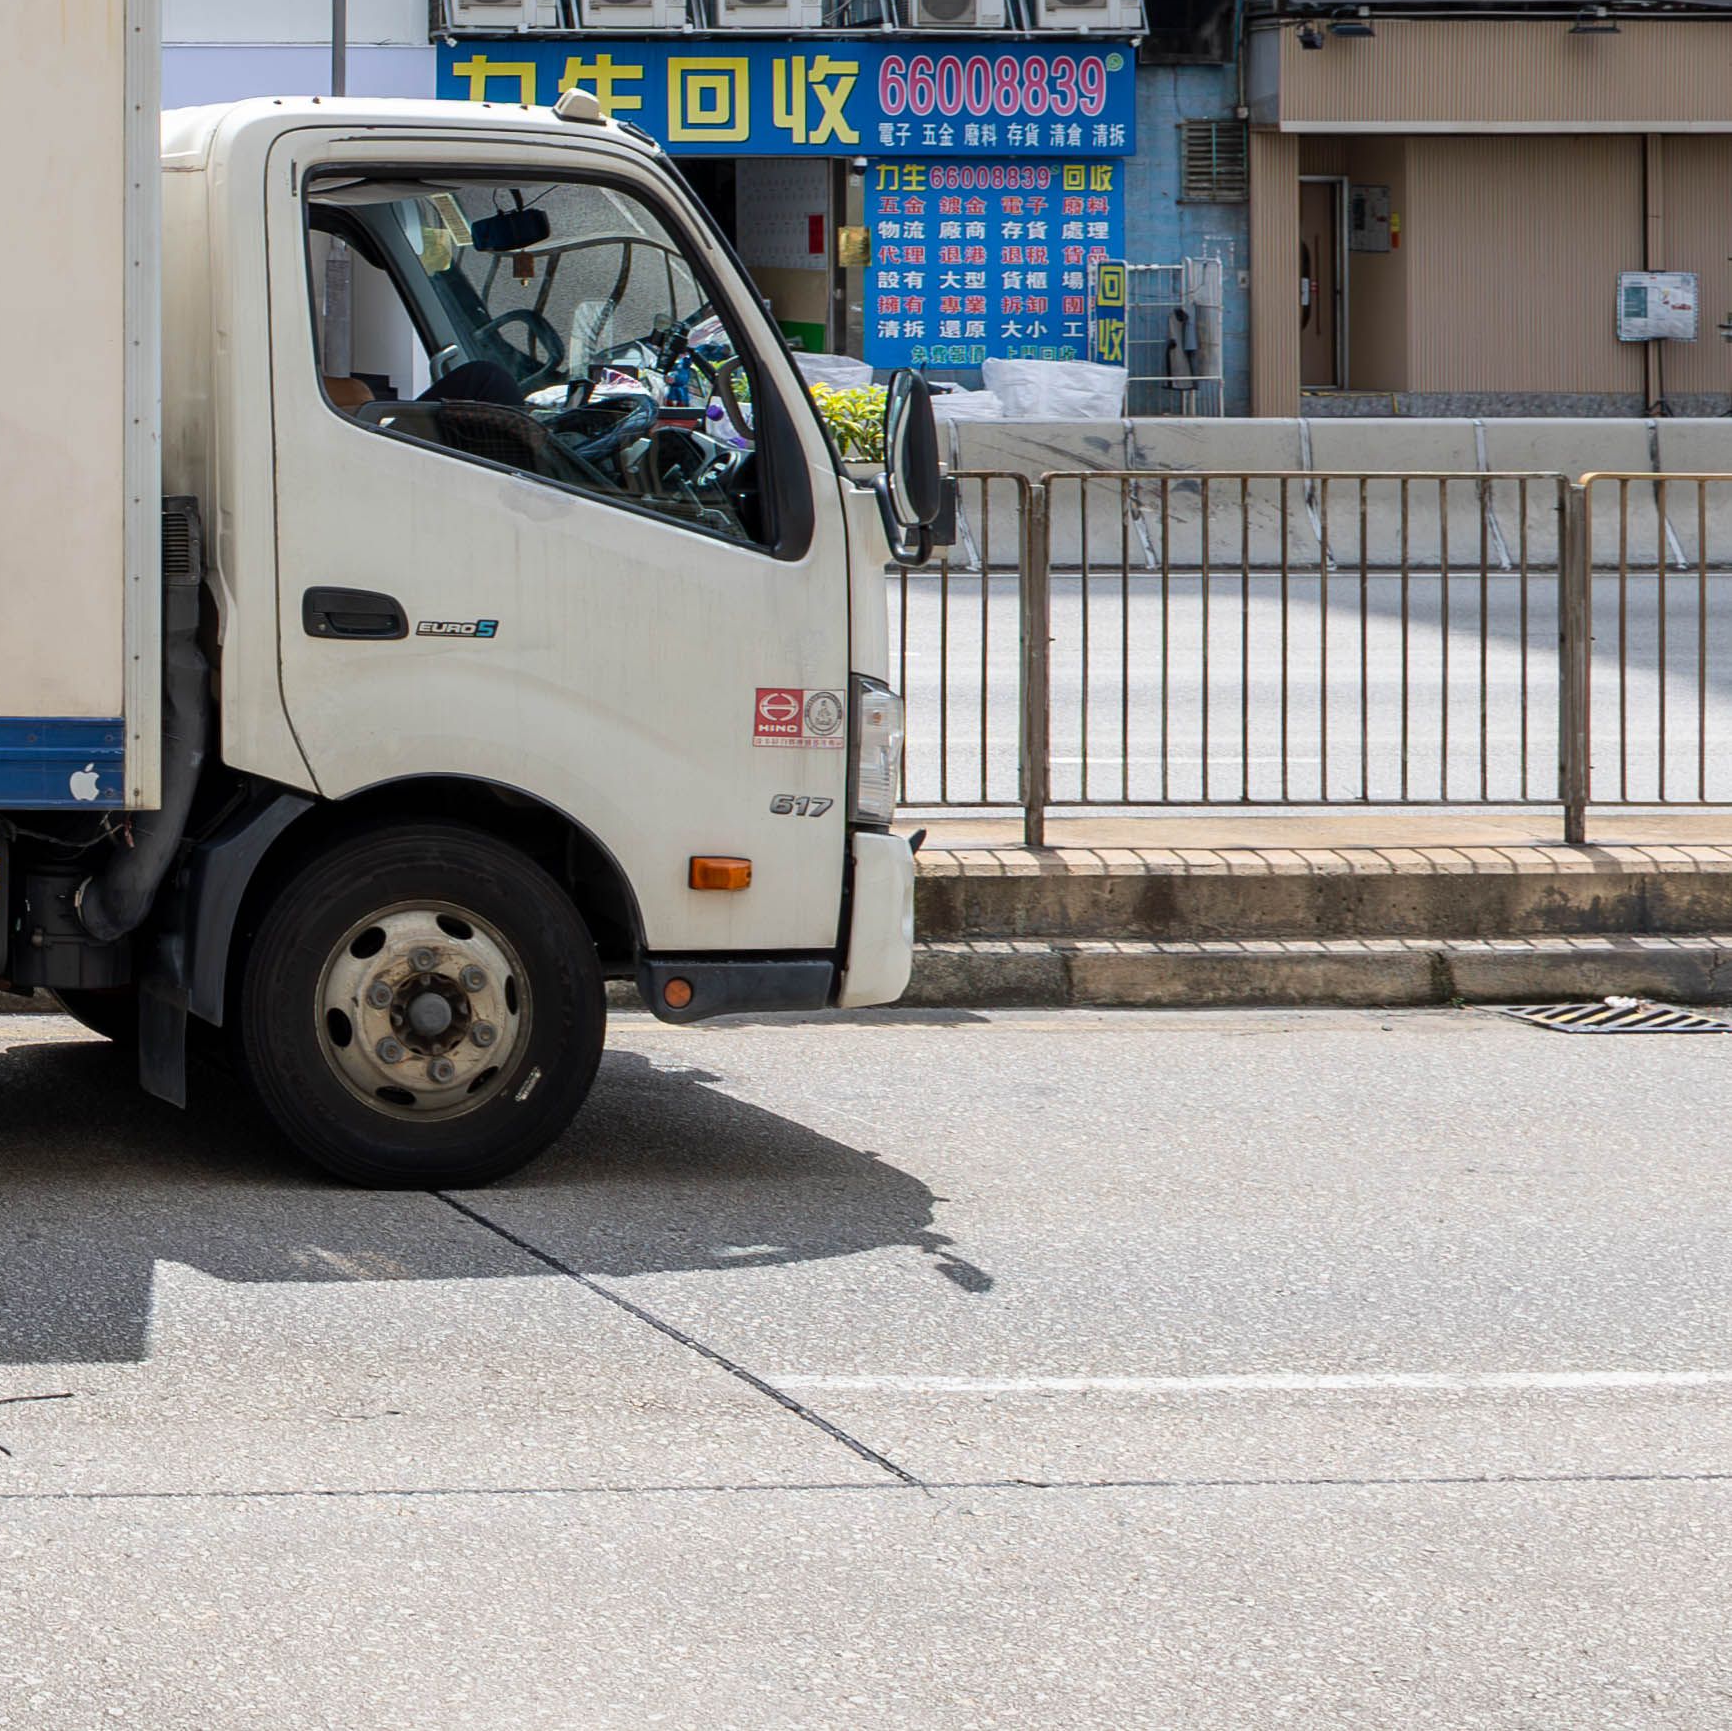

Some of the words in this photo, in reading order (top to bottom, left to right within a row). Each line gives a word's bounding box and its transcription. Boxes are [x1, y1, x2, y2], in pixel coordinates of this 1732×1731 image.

[878, 55, 1107, 116] 66008839
[878, 123, 912, 147] 電子
[922, 123, 954, 147] 五金
[964, 123, 997, 147] 廢料
[1007, 123, 1040, 147] 存貨
[1050, 123, 1083, 147] 清倉
[1092, 123, 1125, 147] 清拆
[875, 165, 926, 191] 力生
[930, 166, 1050, 189] 66008839
[1063, 165, 1113, 191] 回收
[878, 196, 926, 215] 五金
[1001, 196, 1048, 215] 電子
[1062, 196, 1109, 215] 廢料
[878, 221, 926, 240] 物流
[1001, 221, 1048, 240] 存貨
[1062, 221, 1109, 240] 處理
[878, 246, 926, 265] 代理
[939, 246, 986, 265] 退港
[878, 271, 926, 289] 設有
[939, 271, 986, 289] 大型
[1001, 271, 1048, 289] 貨櫃
[878, 295, 926, 315] 擁有
[939, 295, 986, 315] 專業
[1001, 295, 1048, 315] 拆卸
[1097, 266, 1125, 362] 回收
[878, 320, 926, 339] 清拆
[939, 320, 986, 339] 還原
[1001, 320, 1048, 339] 大小
[758, 724, 798, 733] HINO
[769, 794, 834, 817] 617
